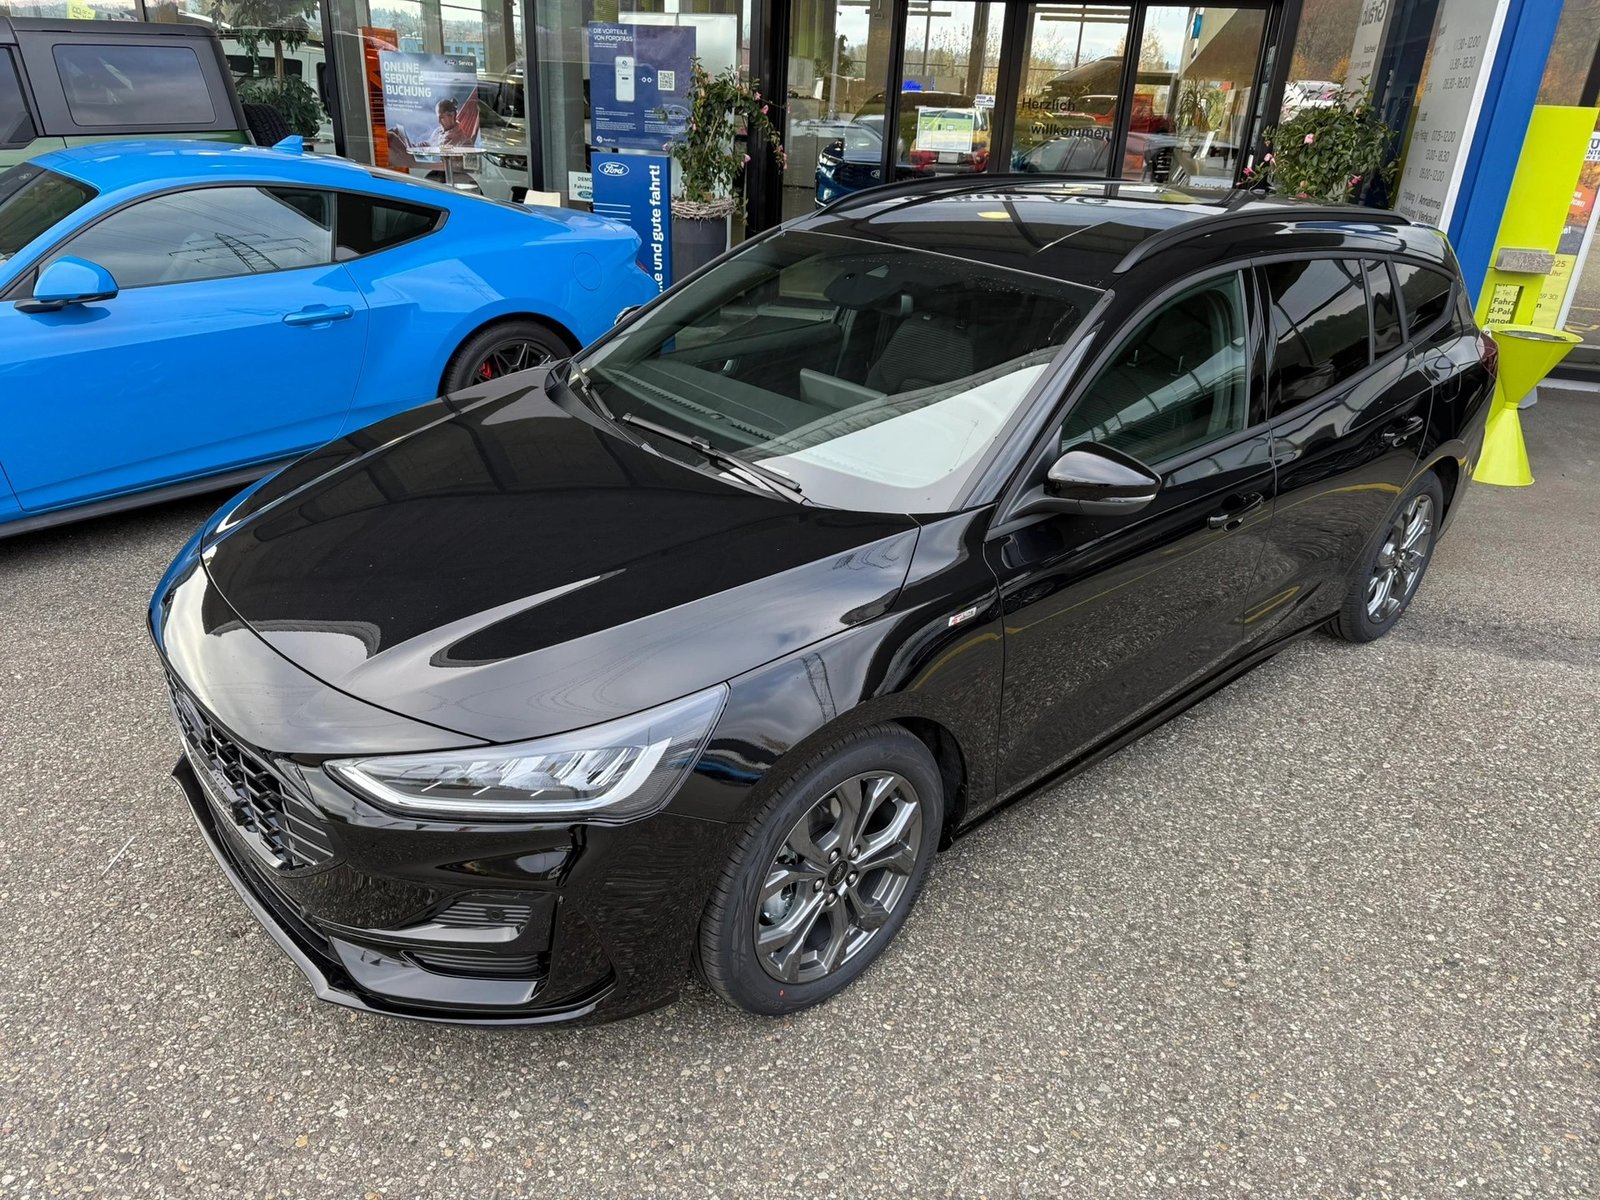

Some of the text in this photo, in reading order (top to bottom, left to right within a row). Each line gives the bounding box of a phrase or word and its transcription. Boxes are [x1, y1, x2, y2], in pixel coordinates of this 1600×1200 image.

[383, 61, 420, 74] ONLINE
[384, 73, 425, 85] SERVICE
[386, 84, 432, 97] BUCHUNG
[1022, 97, 1076, 112] Herzlich
[1031, 124, 1111, 140] willkommen
[601, 162, 627, 175] Ford
[649, 165, 661, 207] fahrt!
[650, 208, 664, 242] gute
[651, 244, 663, 271] und
